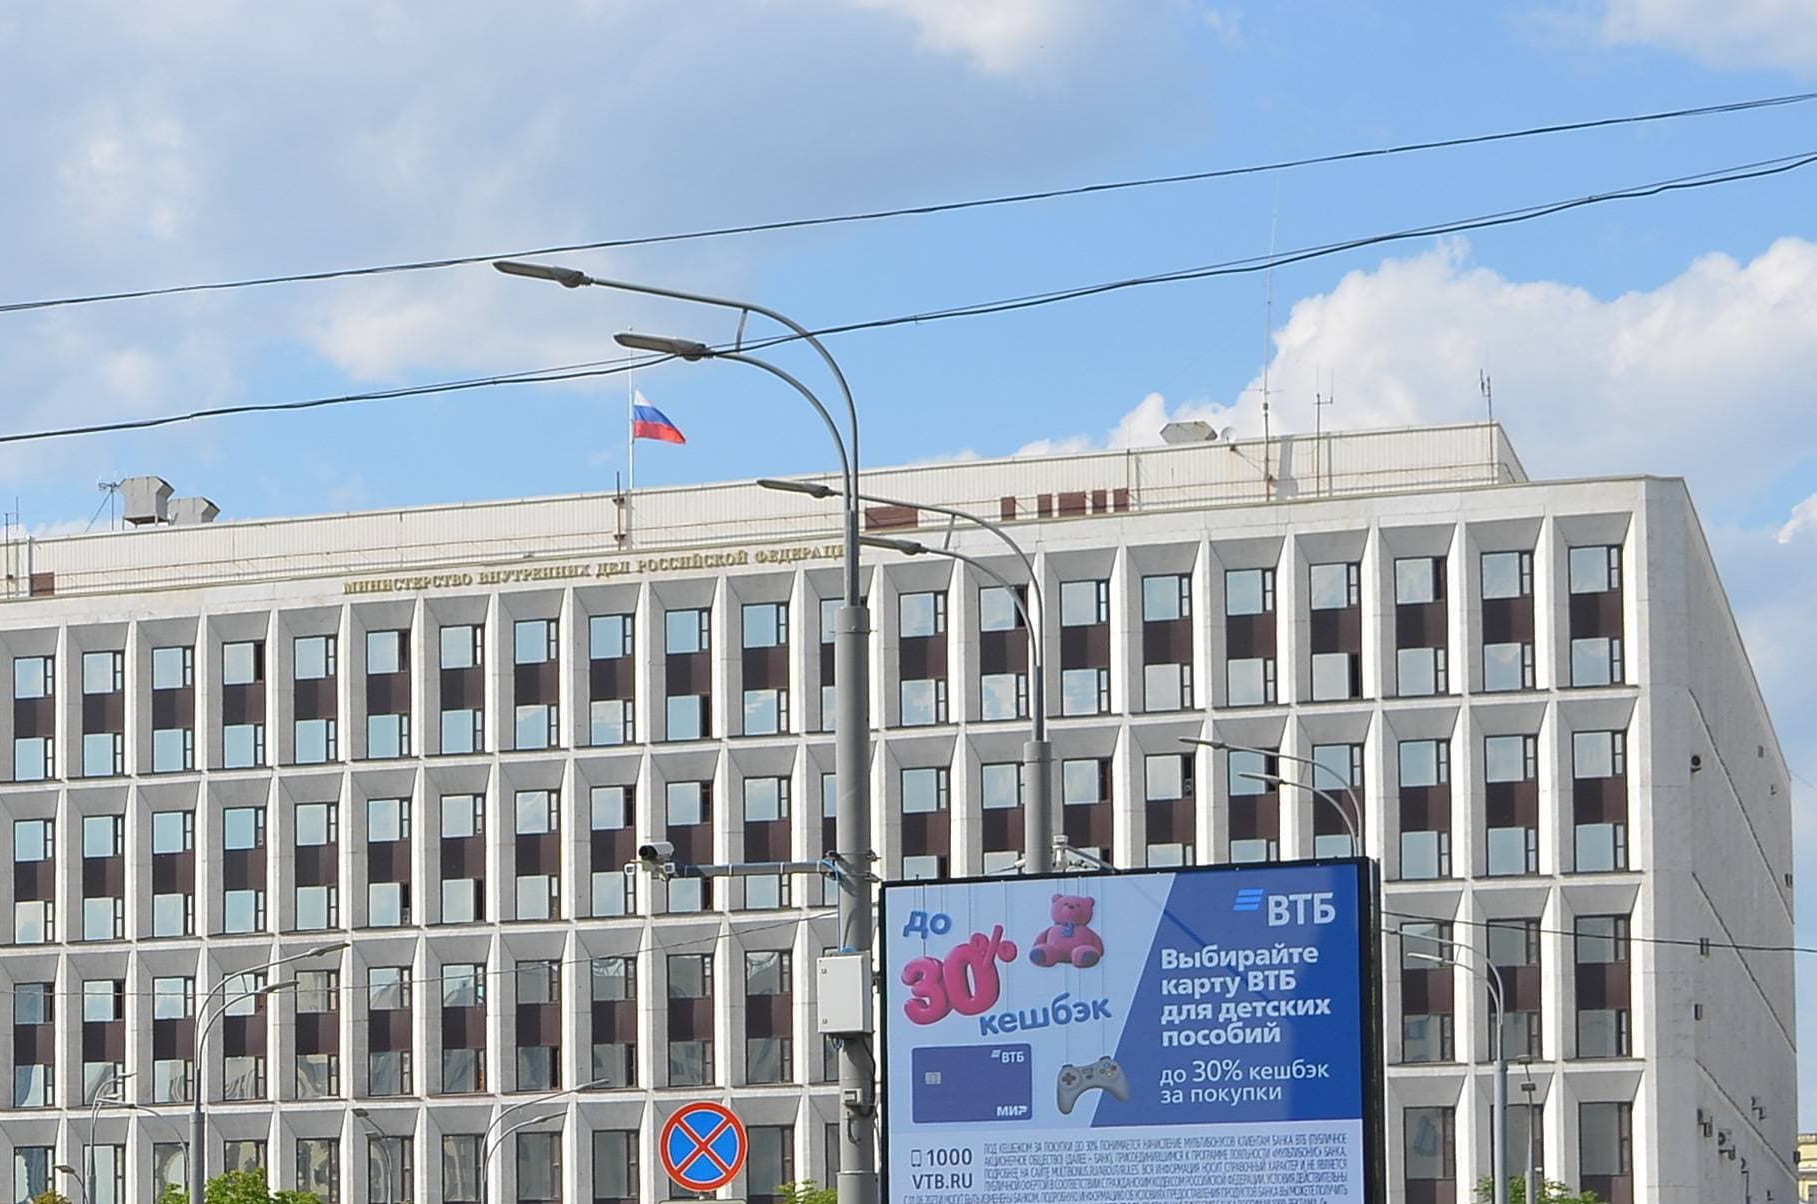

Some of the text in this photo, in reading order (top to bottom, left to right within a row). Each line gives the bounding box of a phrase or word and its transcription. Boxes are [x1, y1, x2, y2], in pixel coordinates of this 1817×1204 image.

[343, 543, 845, 595] МИНИСТЕРСТВО ВНУТРЕННИХ ДЕЛ РОССИЙСКОЙ ФЕДЕРАЦ
[1267, 891, 1337, 927] ВТБ
[1160, 942, 1320, 971] Выбирайте
[901, 924, 1019, 1026] 30%
[1161, 969, 1298, 1000] карту ВТБ
[979, 992, 1113, 1037] кешбэк
[1160, 997, 1332, 1025] для детских
[1162, 1021, 1282, 1048] пособий
[1001, 1051, 1025, 1064] ВТБ
[1159, 1058, 1330, 1087] до 30% кешбэк
[1159, 1086, 1283, 1107] за покупки
[996, 1105, 1028, 1117] МИР
[926, 1147, 973, 1167] 1000
[911, 1172, 974, 1190] VTB.RU
